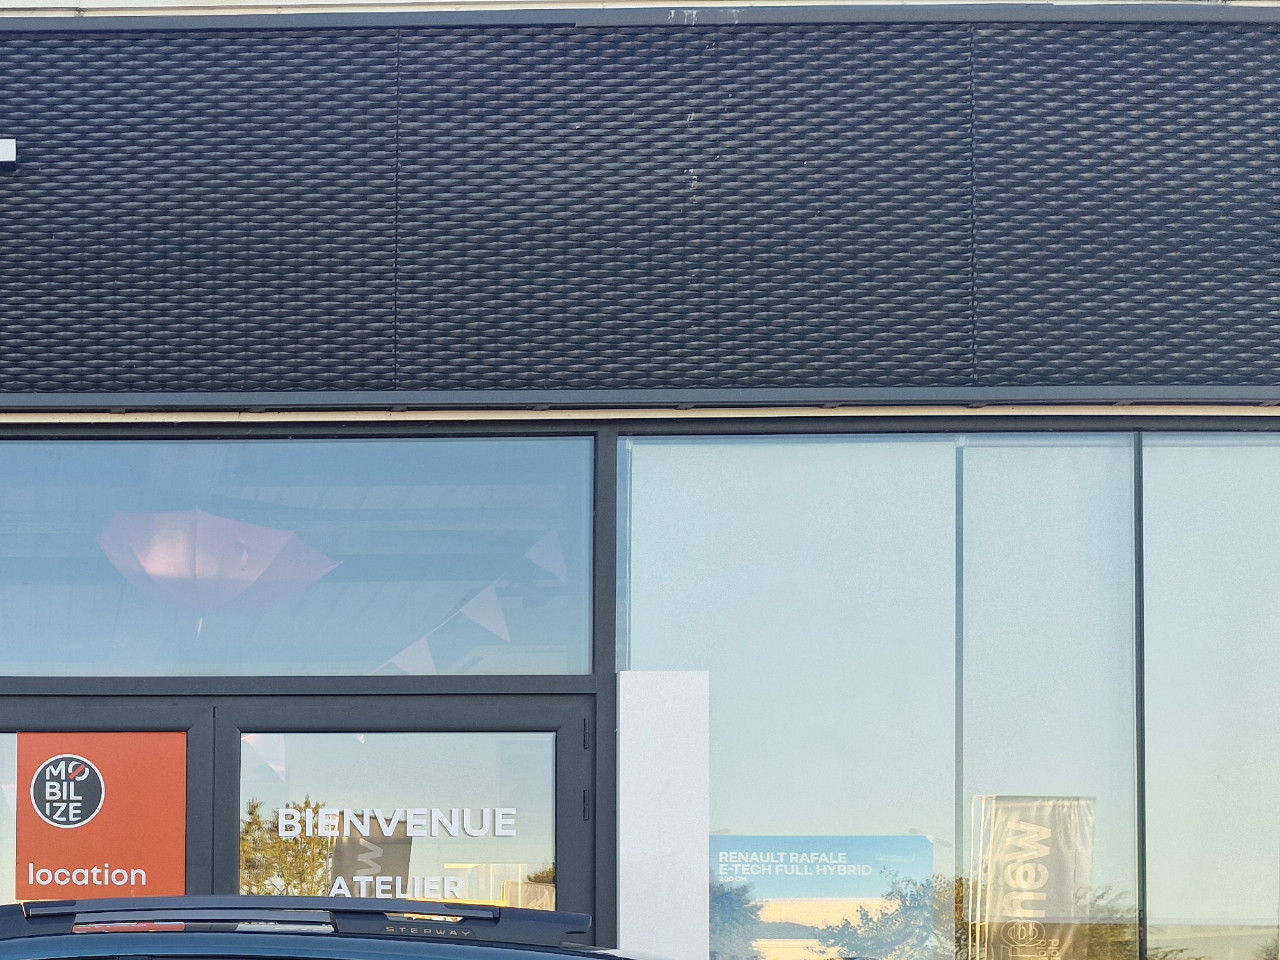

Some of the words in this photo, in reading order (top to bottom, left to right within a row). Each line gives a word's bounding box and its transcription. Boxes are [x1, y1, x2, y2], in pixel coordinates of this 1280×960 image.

[278, 807, 517, 838] BIENVENUE
[719, 852, 787, 863] RENAULT
[789, 853, 847, 863] RAFALE
[28, 863, 147, 885] location
[719, 864, 771, 875] E-TECH
[775, 864, 813, 875] FULL
[815, 864, 873, 876] HYBRID
[328, 875, 465, 899] ATELIER
[385, 926, 471, 936] STEPWAY
